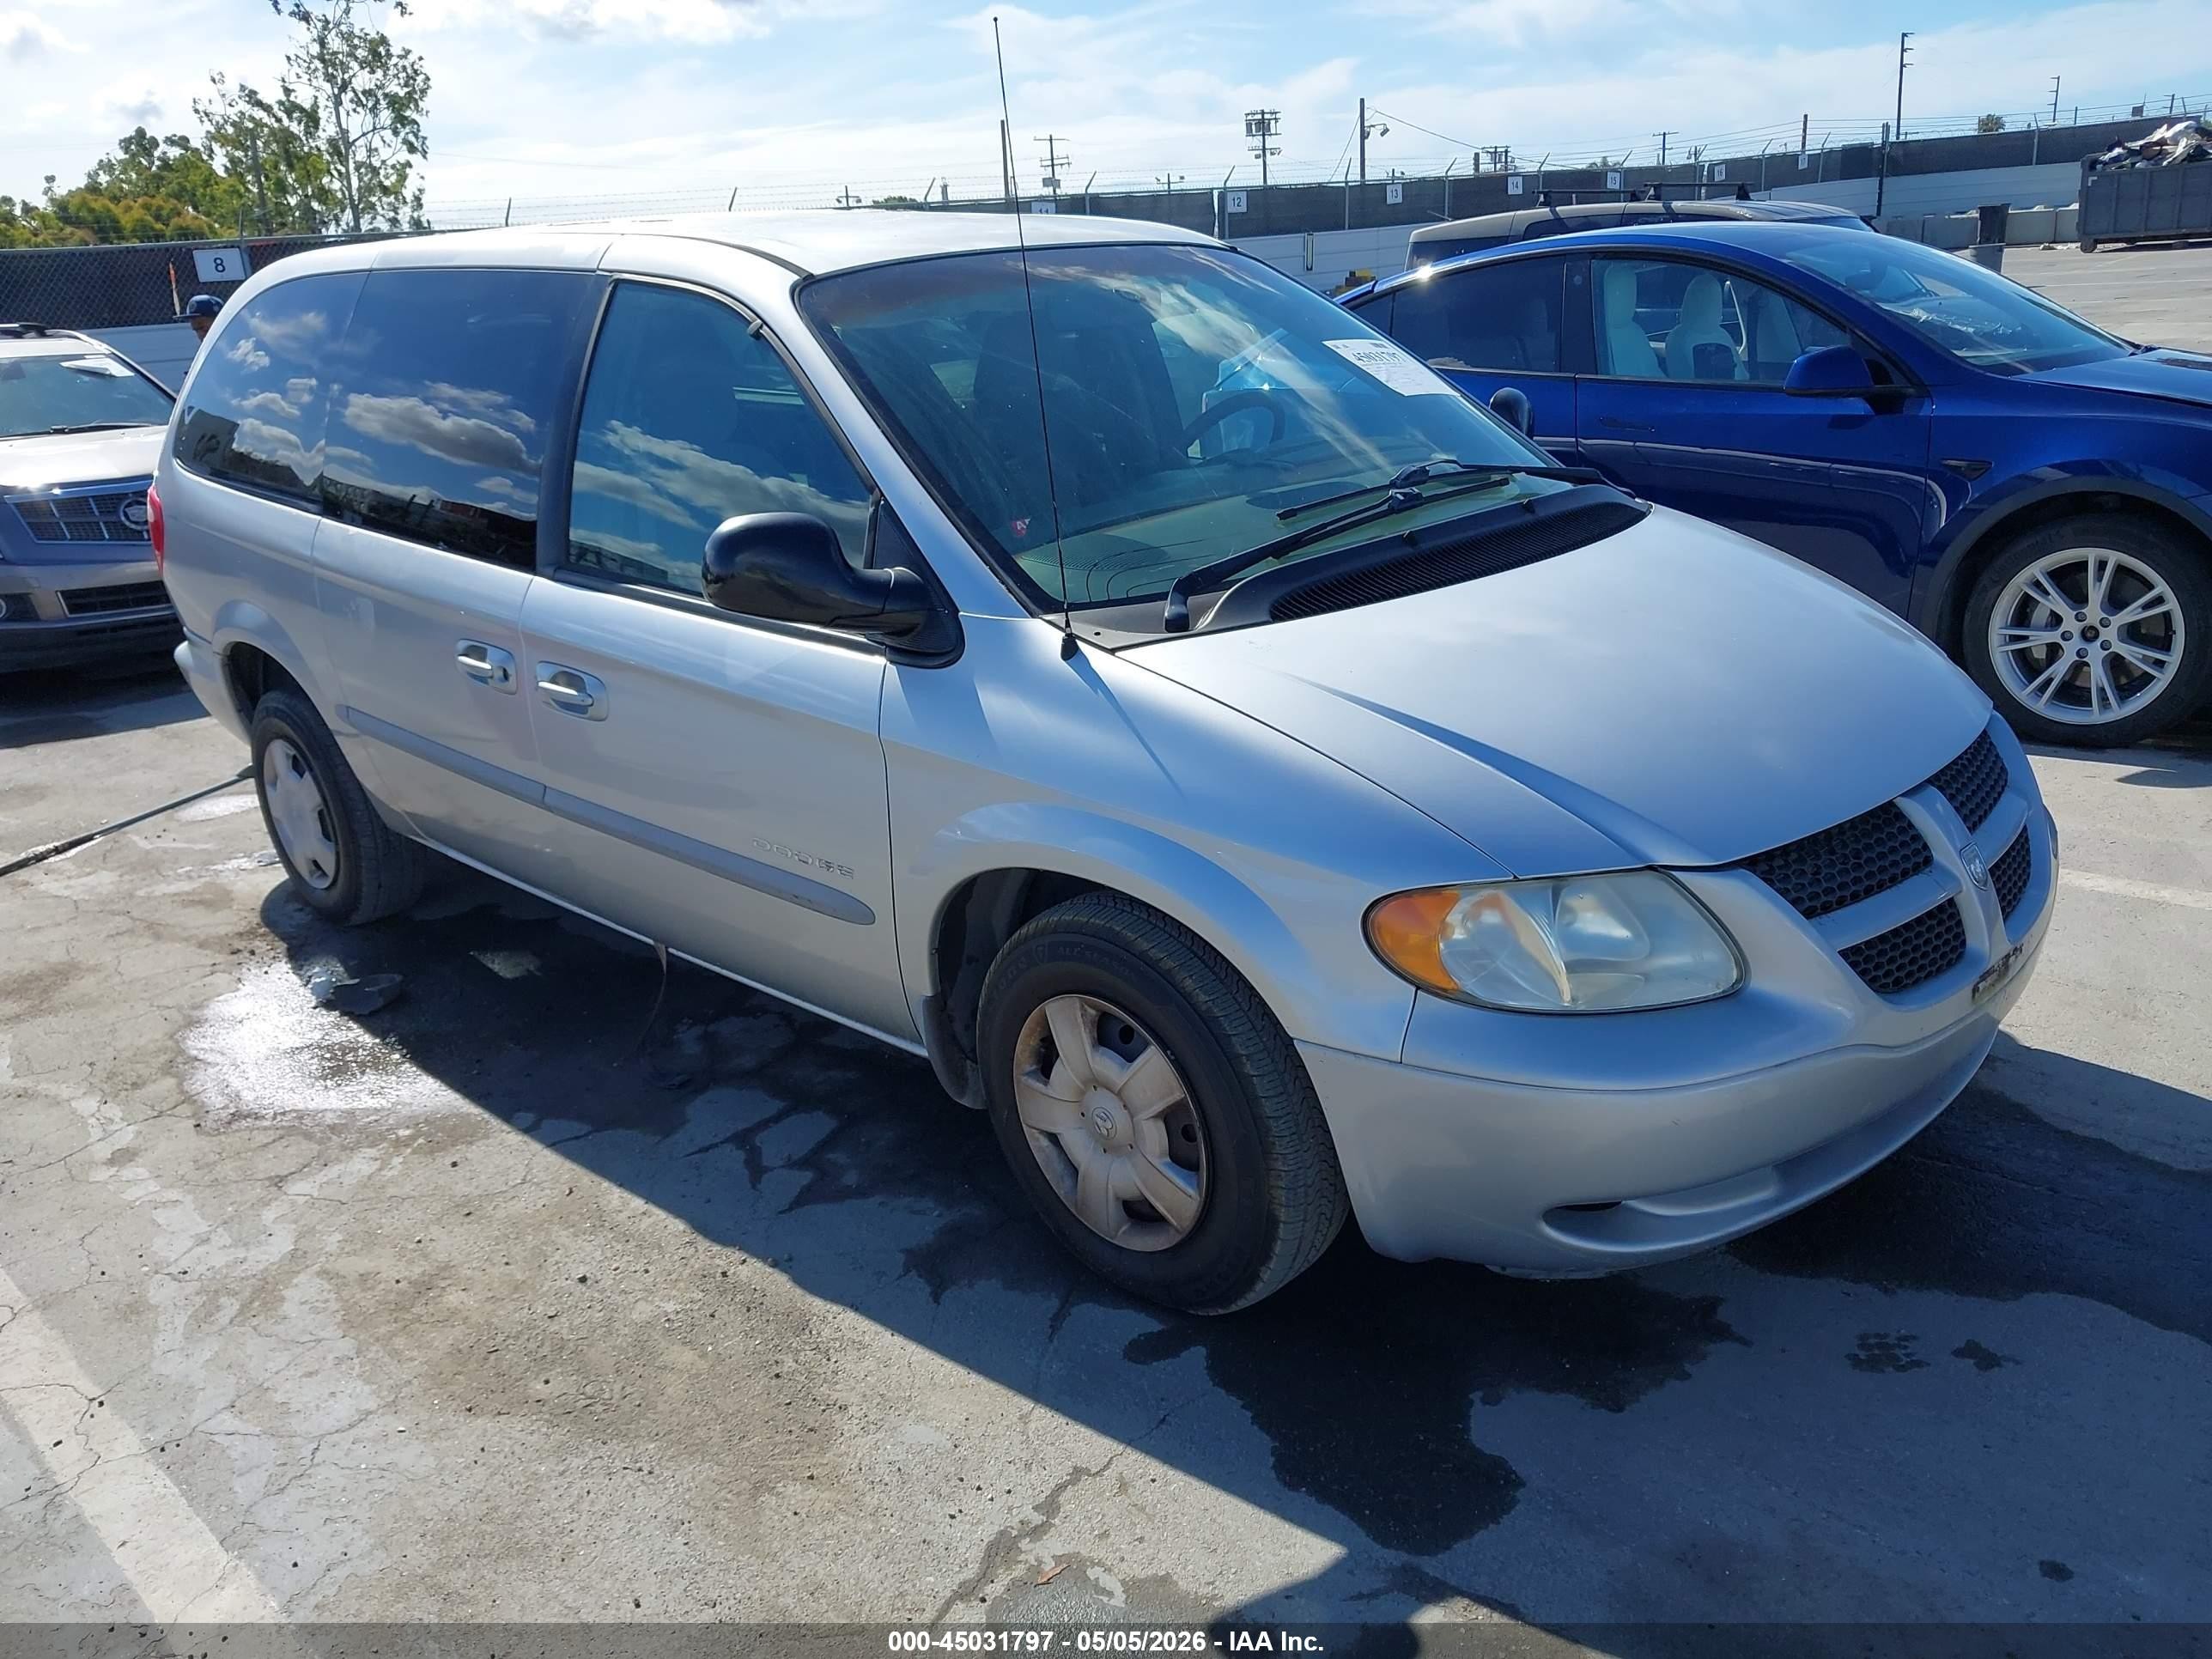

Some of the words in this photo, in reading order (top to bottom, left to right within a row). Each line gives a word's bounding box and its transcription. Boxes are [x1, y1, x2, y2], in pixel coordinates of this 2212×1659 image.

[1717, 168, 1723, 177] 16
[1511, 181, 1519, 190] 14
[1610, 176, 1617, 185] 15
[1390, 189, 1399, 199] 13
[1232, 198, 1242, 208] 12
[213, 257, 226, 273] 8
[1352, 350, 1407, 363] 45031797
[751, 838, 854, 880] DODGE
